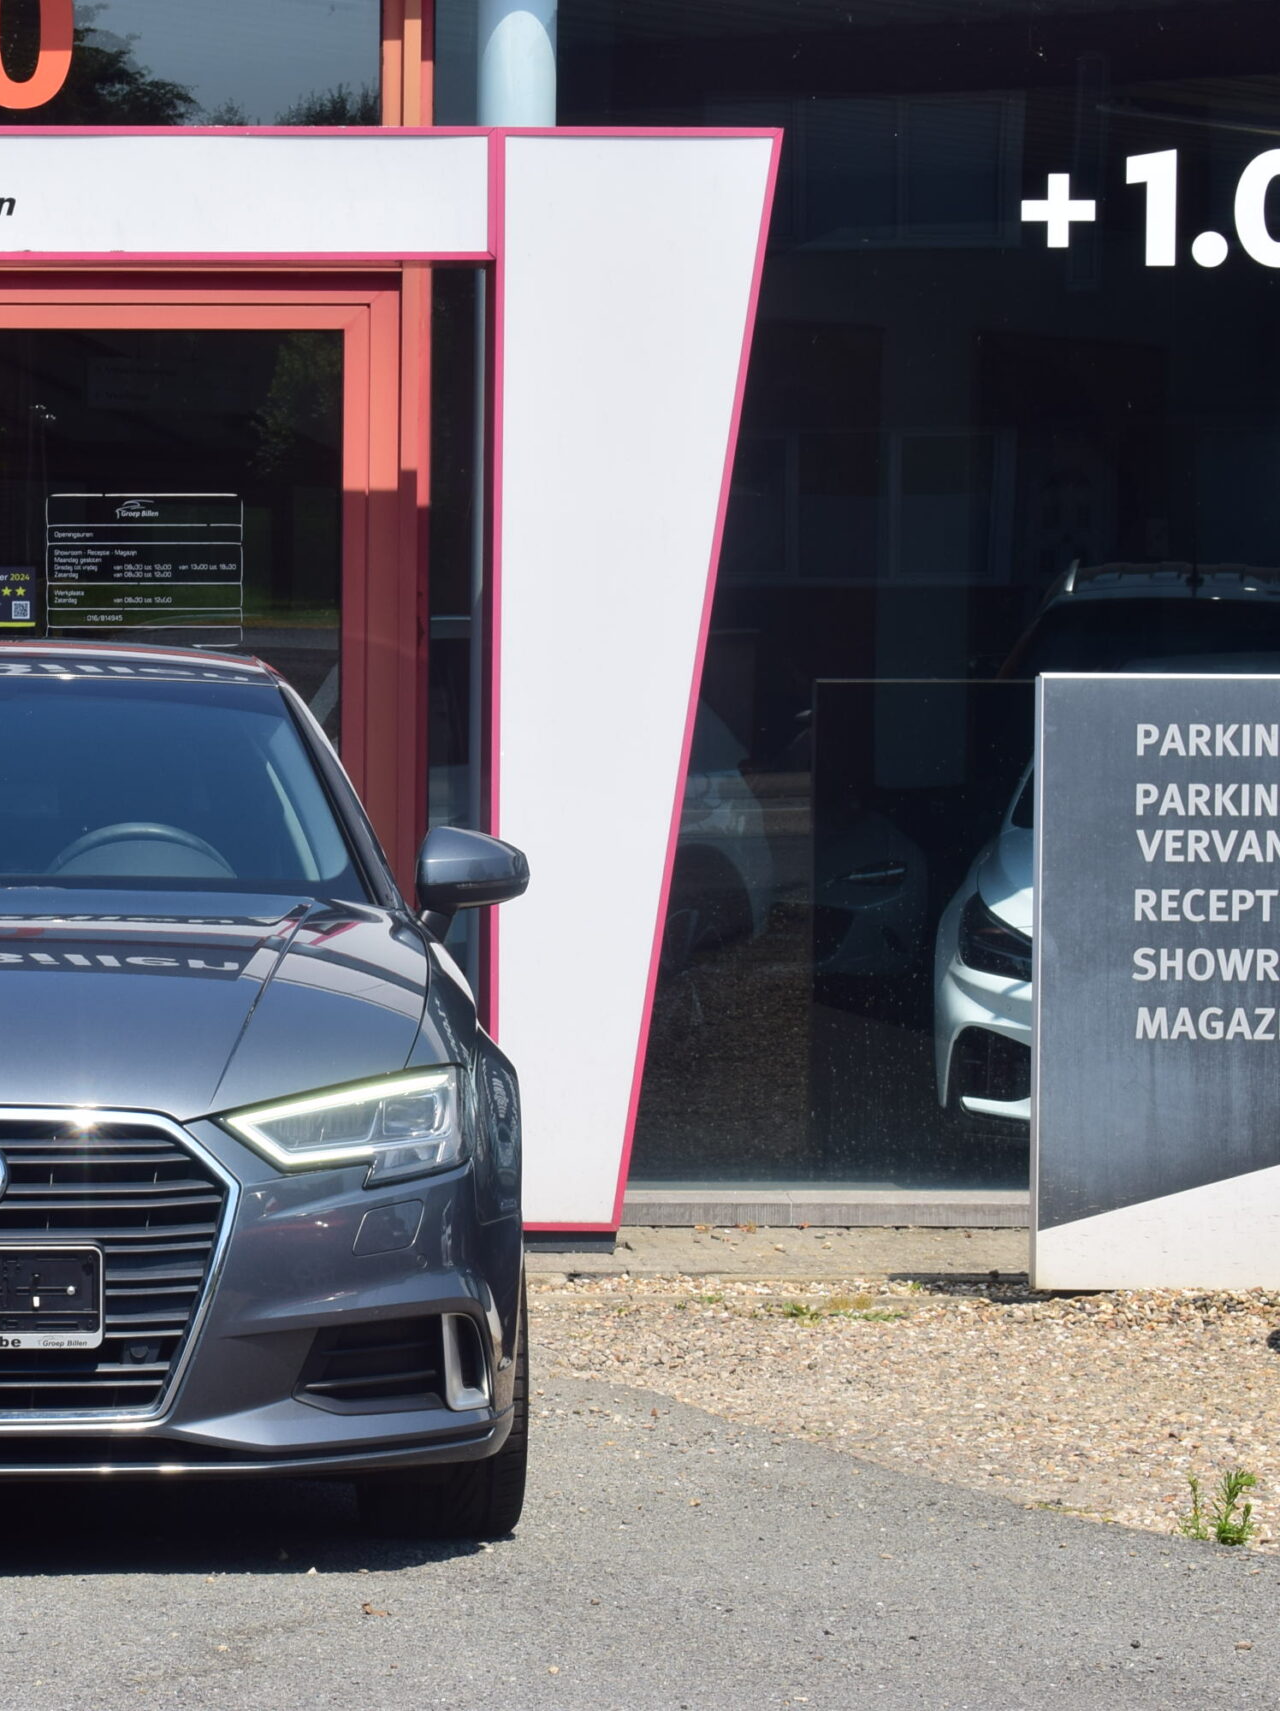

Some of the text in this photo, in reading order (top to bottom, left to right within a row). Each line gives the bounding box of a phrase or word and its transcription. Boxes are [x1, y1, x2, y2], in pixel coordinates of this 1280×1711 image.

[10, 573, 30, 581] 2024
[1136, 723, 1279, 757] PARKIN
[1135, 783, 1278, 817] PARKIN
[1136, 829, 1280, 863] VERVAN
[1134, 889, 1278, 922] RECEPT
[1132, 948, 1280, 982] SHOWR
[1135, 1007, 1280, 1041] MAGAZ
